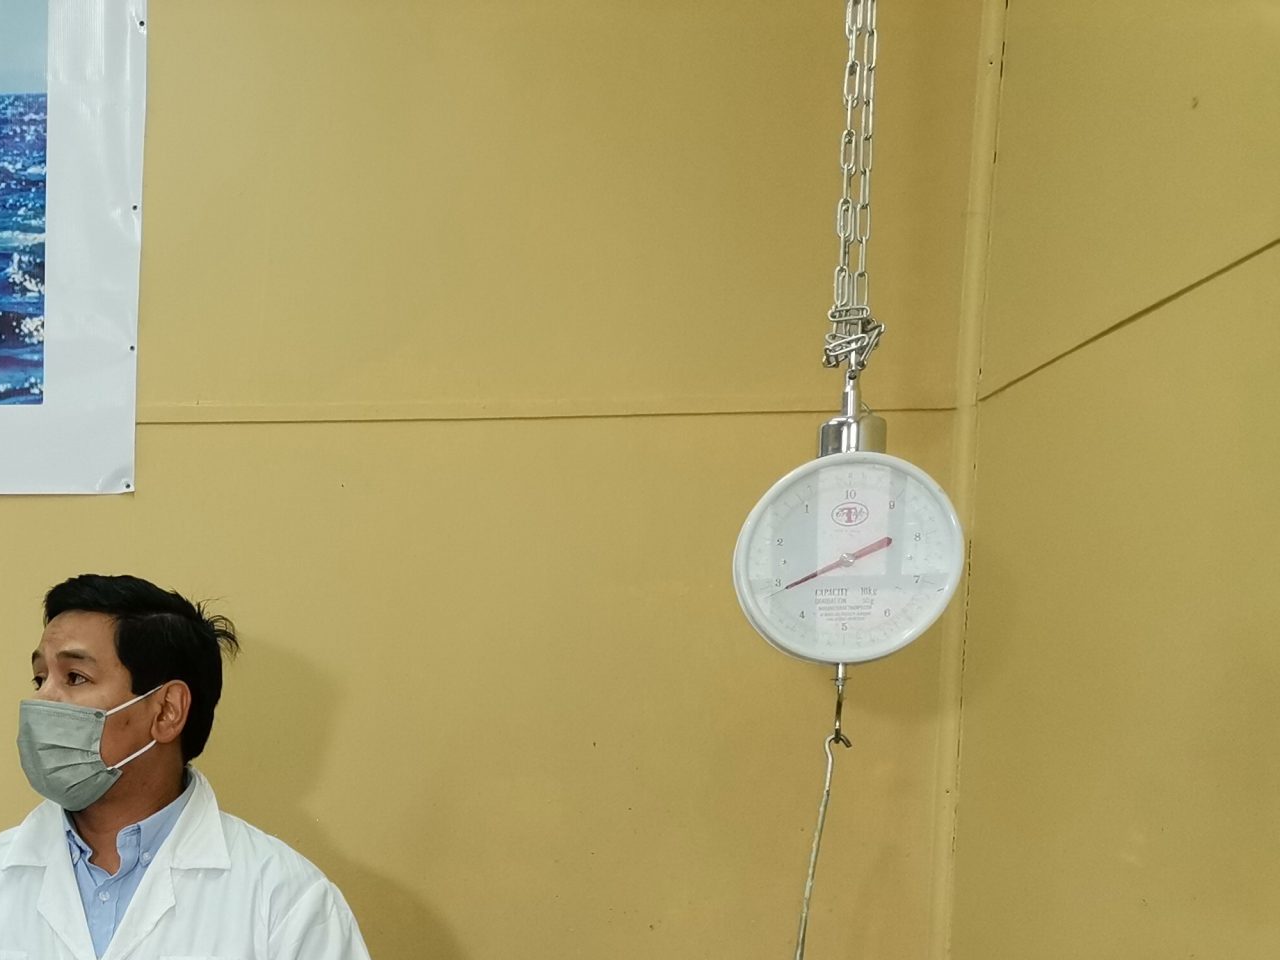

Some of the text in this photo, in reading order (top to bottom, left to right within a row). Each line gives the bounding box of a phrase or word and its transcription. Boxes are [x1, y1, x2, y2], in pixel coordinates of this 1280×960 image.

[845, 489, 856, 499] 10
[914, 533, 921, 541] 8
[777, 538, 784, 546] 2
[775, 578, 782, 587] 3
[914, 576, 920, 584] 7
[800, 611, 805, 619] 4
[884, 609, 891, 617] 6
[841, 623, 848, 631] 5
